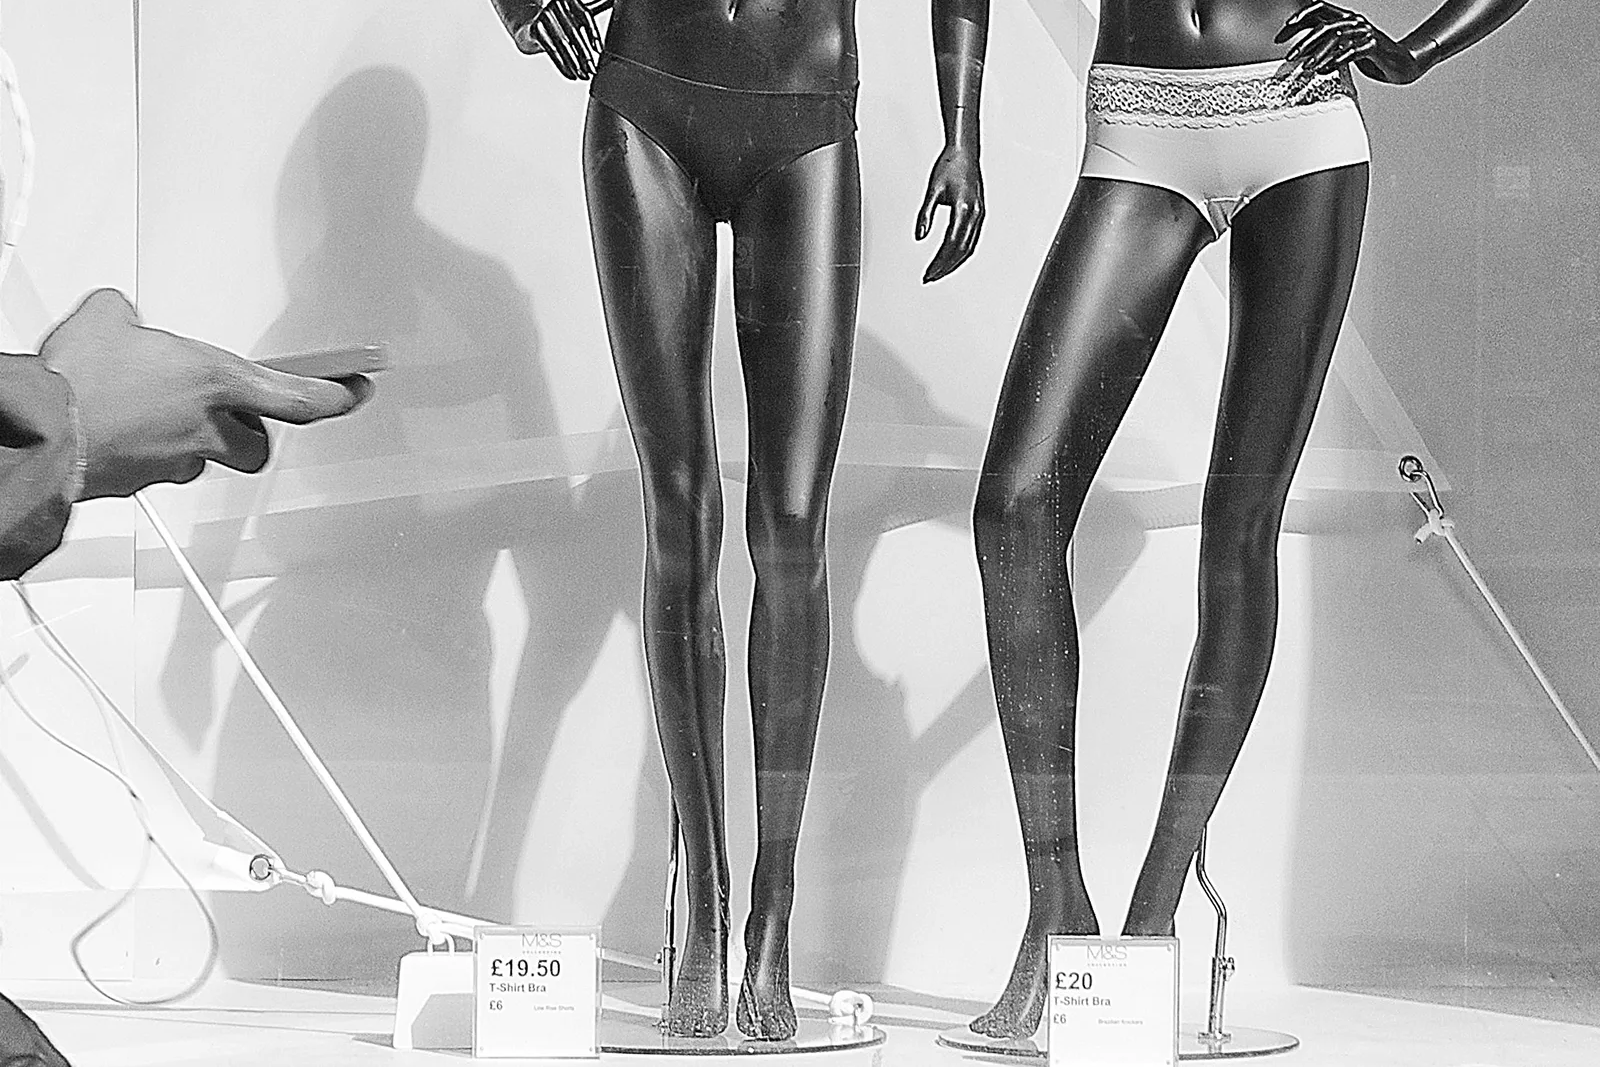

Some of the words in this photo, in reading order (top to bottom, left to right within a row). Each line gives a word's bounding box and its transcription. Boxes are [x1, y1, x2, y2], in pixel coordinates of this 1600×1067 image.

[521, 932, 562, 947] M&S
[1086, 944, 1128, 960] M&S
[490, 958, 561, 978] £19.50
[1055, 971, 1093, 990] £20
[489, 982, 525, 993] T-Shirt
[528, 982, 546, 993] Bra
[489, 1000, 503, 1011] £6
[1053, 996, 1089, 1006] T-Shirt
[1092, 996, 1111, 1006] Bra
[1053, 1013, 1067, 1024] £6
